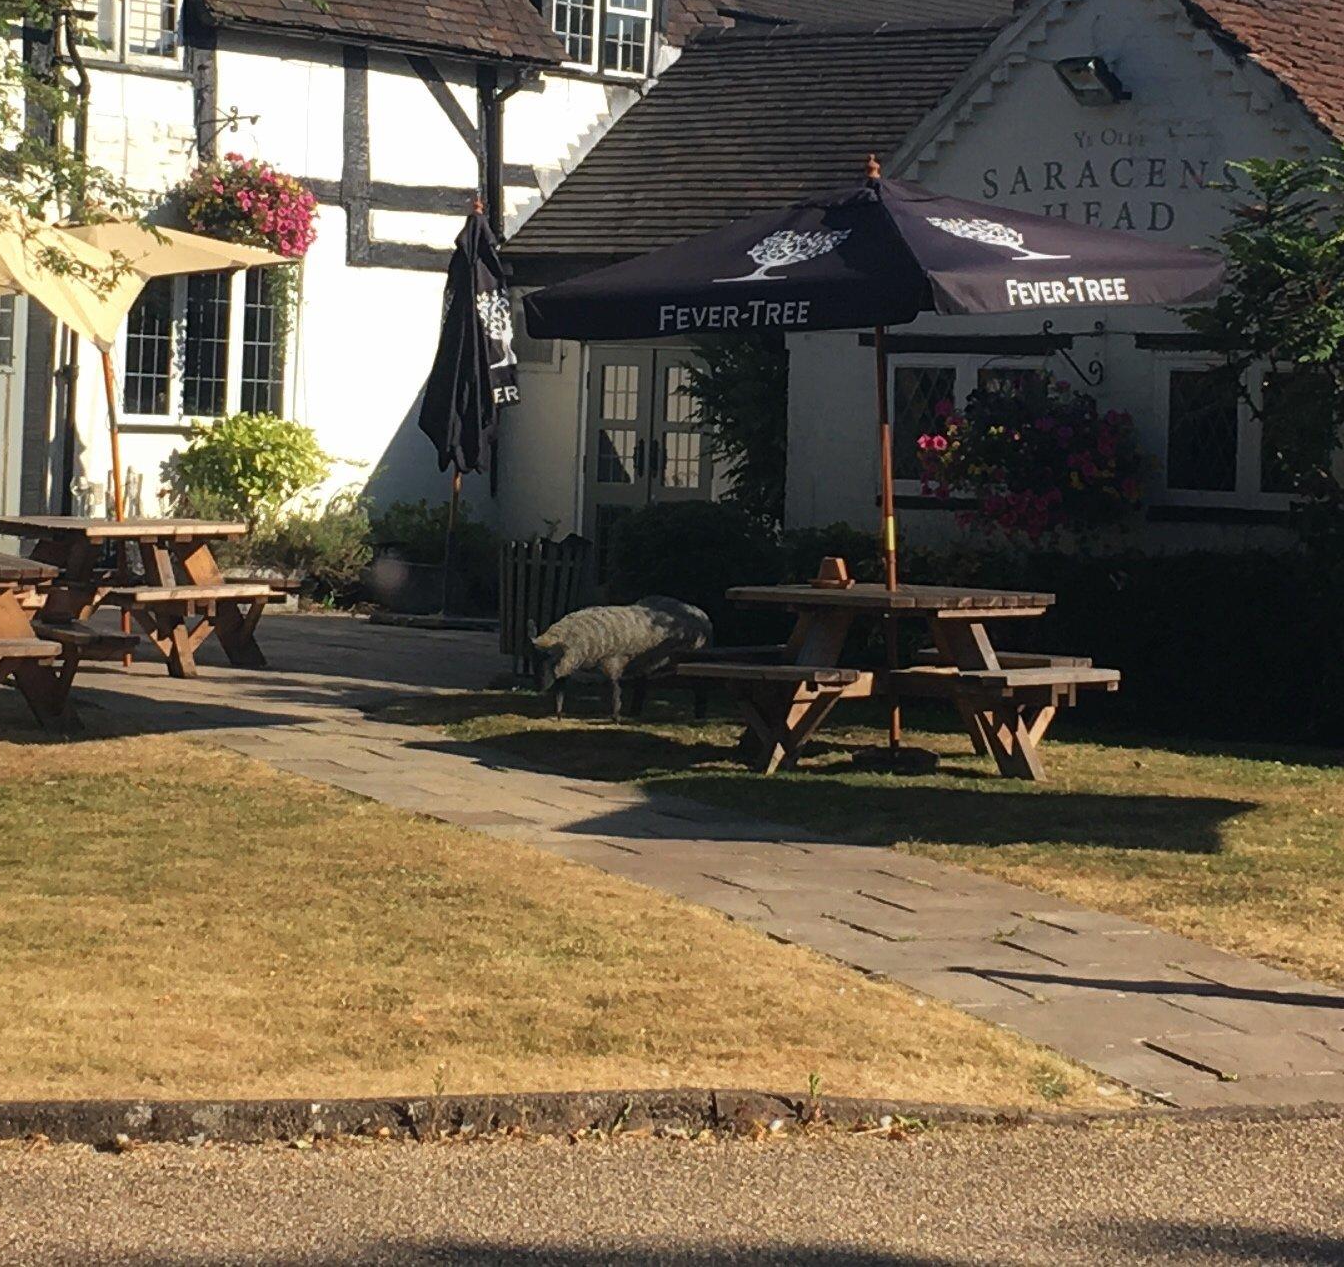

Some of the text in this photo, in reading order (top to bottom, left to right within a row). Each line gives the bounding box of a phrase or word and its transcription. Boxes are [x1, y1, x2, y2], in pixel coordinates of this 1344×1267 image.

[982, 157, 1240, 200] SARACENS
[1005, 276, 1129, 306] FEVER-TREE
[658, 300, 811, 331] FEVER-TREE
